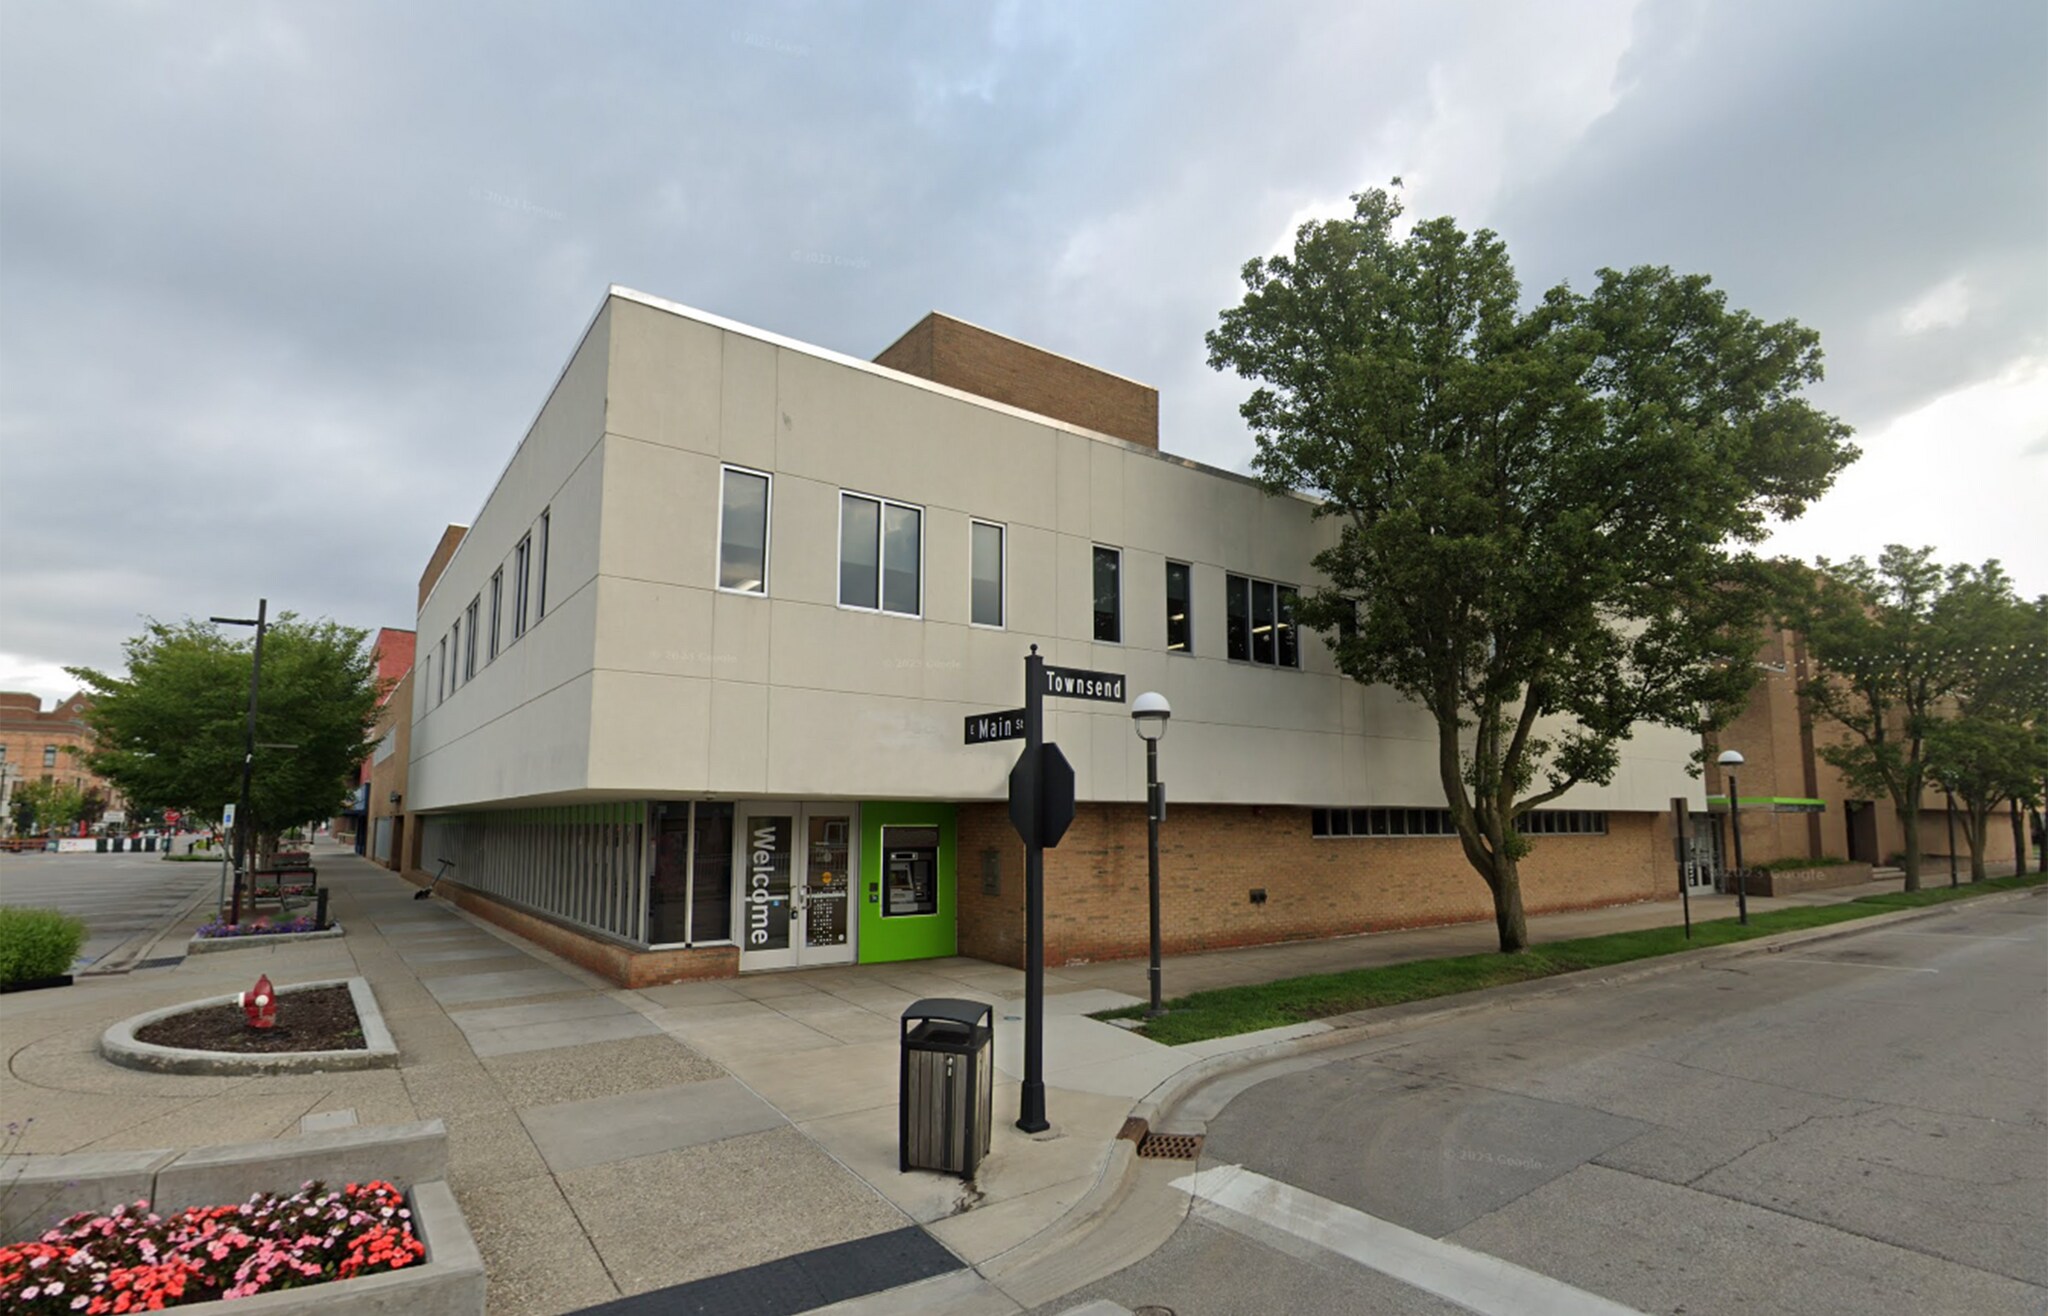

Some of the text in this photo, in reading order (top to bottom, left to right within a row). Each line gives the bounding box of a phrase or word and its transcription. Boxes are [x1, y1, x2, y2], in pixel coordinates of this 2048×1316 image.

[1046, 671, 1121, 698] Townsend
[970, 717, 1024, 739] E Main St
[751, 826, 776, 944] Welcome
